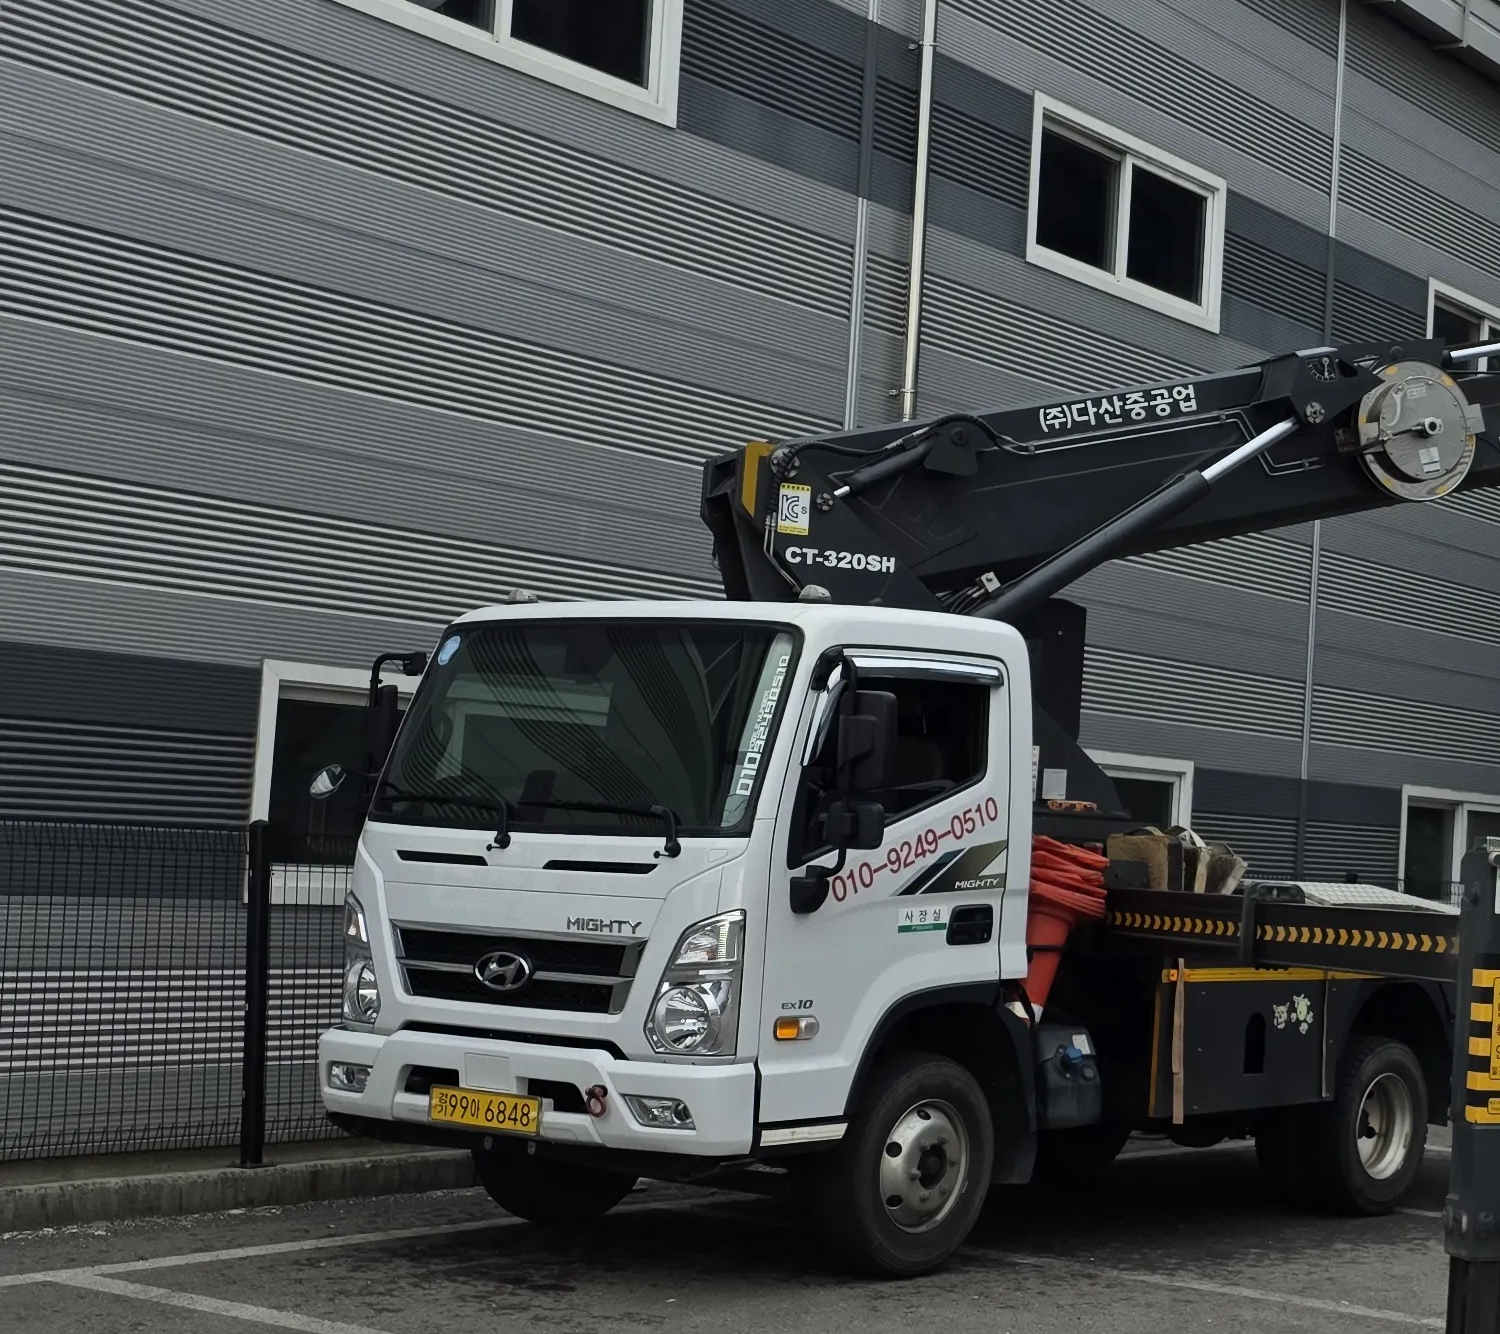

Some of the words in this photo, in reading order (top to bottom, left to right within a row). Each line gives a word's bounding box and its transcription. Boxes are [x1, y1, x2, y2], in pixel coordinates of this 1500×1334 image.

[1039, 384, 1198, 433] (주)다산중공업
[785, 546, 896, 573] CT-320SH
[832, 797, 998, 902] 010-9249-0510
[954, 878, 1000, 889] MIGHTY
[566, 916, 642, 935] MIGHTY
[904, 909, 941, 923] 사장실
[781, 999, 813, 1010] EX10
[484, 1099, 531, 1127] 6848
